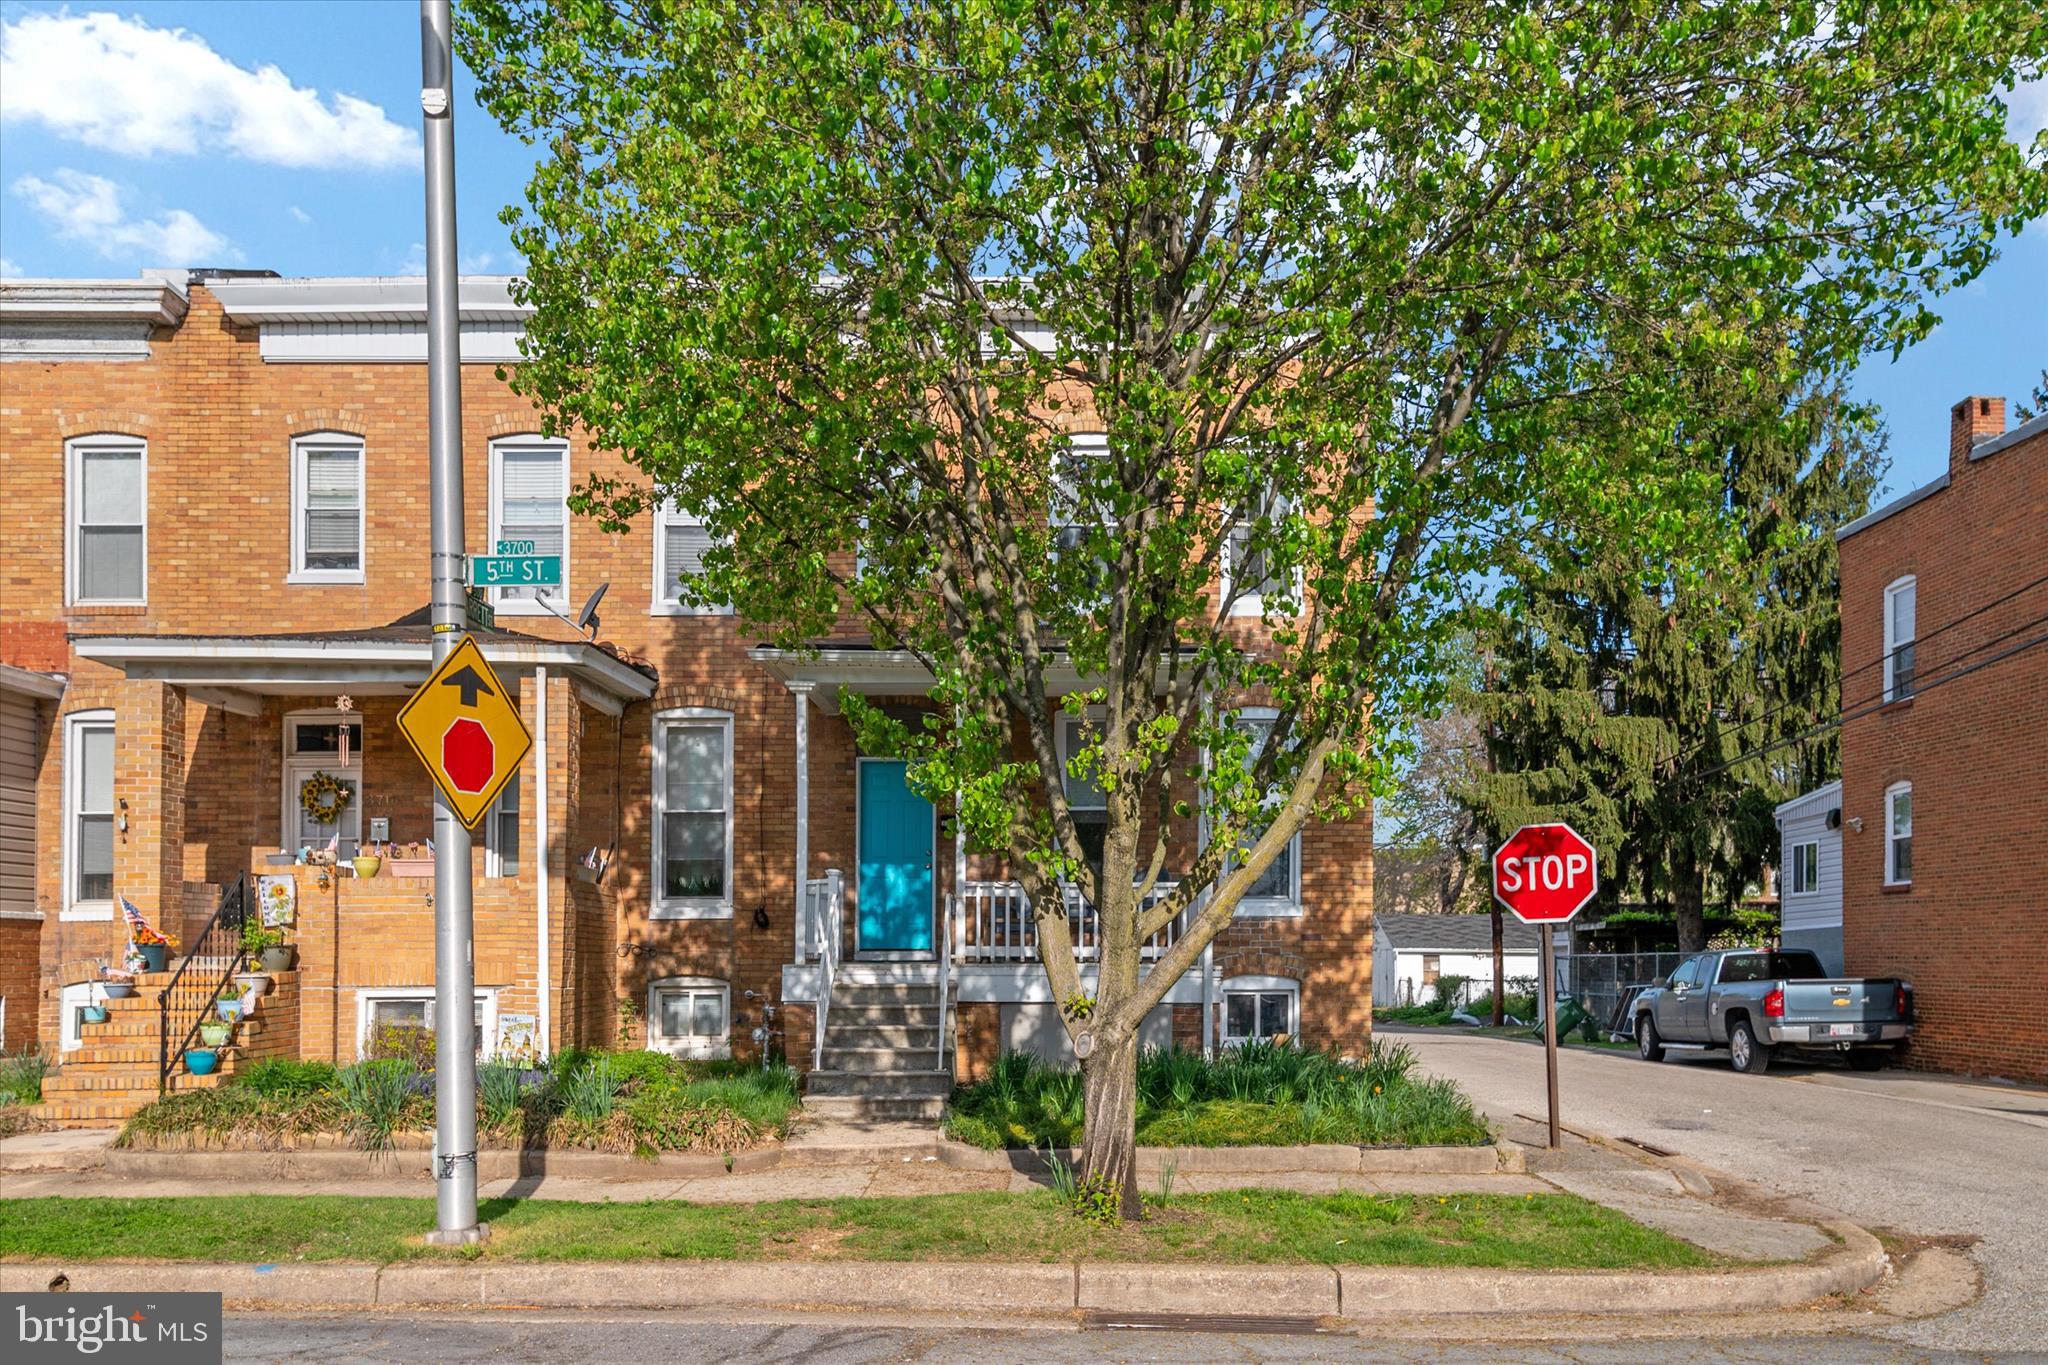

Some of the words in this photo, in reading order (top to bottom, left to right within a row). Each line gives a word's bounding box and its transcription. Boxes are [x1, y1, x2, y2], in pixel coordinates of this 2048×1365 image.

[503, 541, 534, 555] 3700
[487, 560, 514, 581] 5TH
[522, 560, 549, 581] ST.
[1502, 854, 1588, 892] STOP
